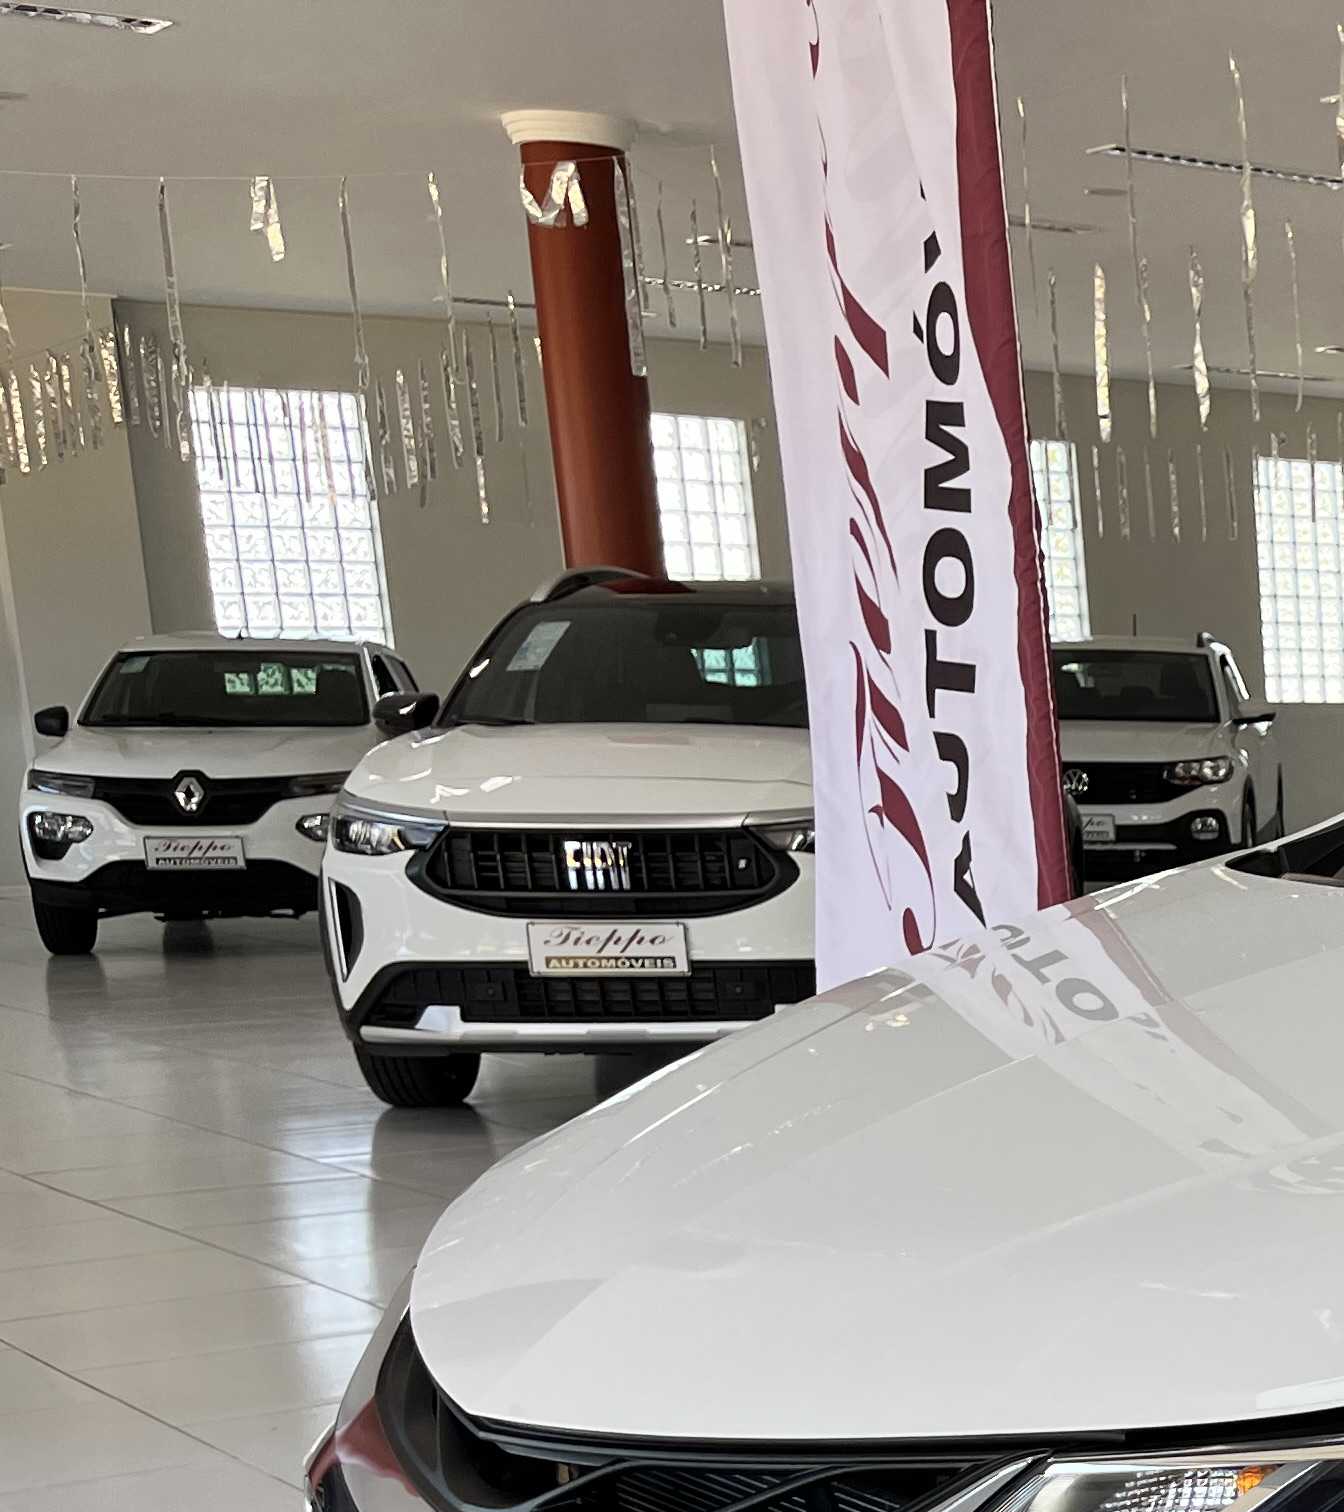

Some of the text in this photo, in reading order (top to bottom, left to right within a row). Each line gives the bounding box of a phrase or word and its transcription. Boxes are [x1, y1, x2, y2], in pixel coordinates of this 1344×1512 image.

[564, 840, 633, 890] FIAT
[544, 925, 674, 954] Tieppo
[549, 956, 675, 969] AUTOMÓVEIS
